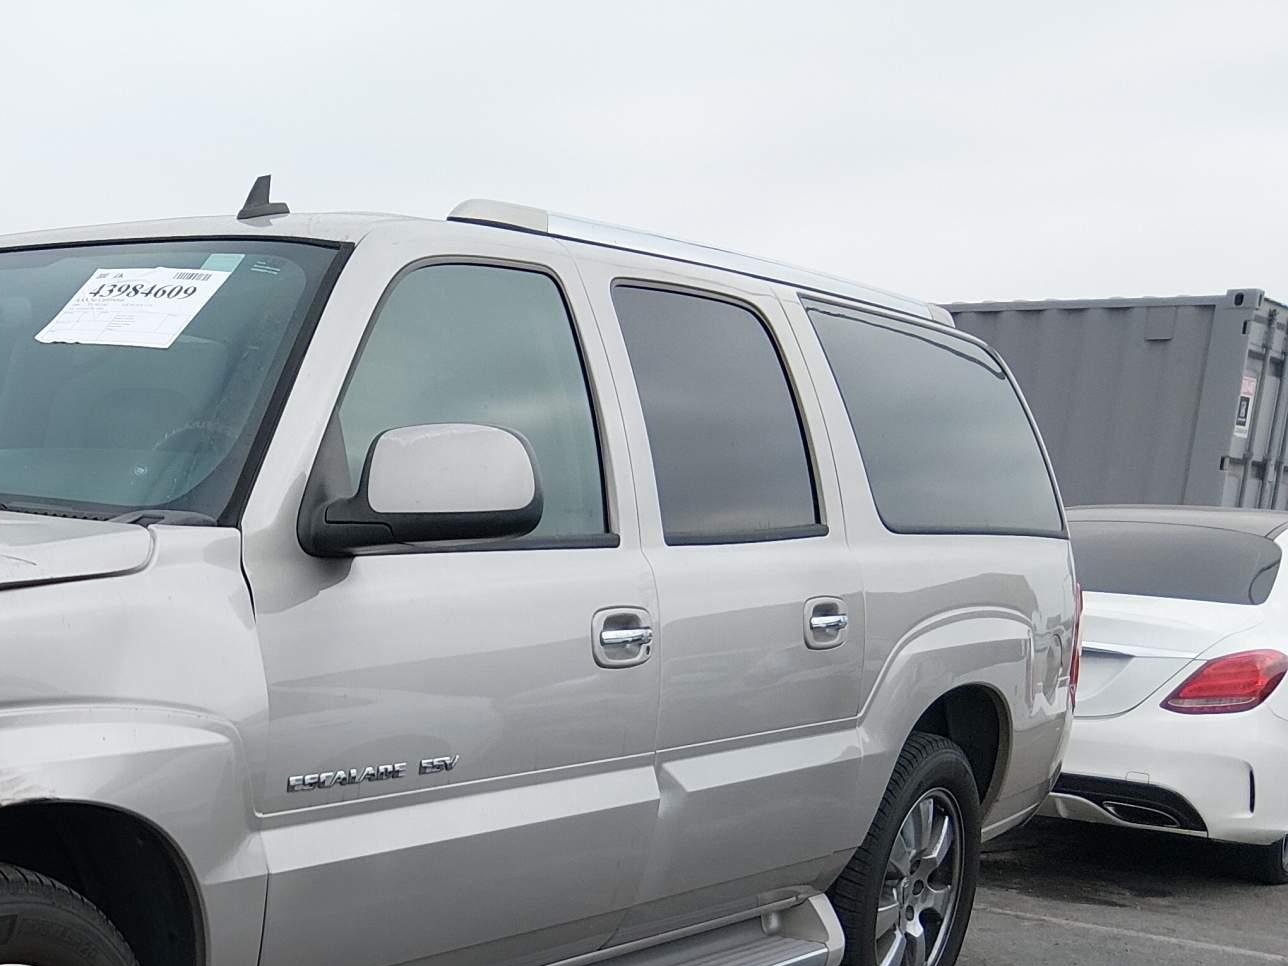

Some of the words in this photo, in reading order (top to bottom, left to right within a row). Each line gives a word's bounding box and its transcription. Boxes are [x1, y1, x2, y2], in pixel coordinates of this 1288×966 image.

[89, 282, 198, 299] 43984609
[287, 762, 408, 793] ESCALADE
[418, 755, 460, 776] ESV
